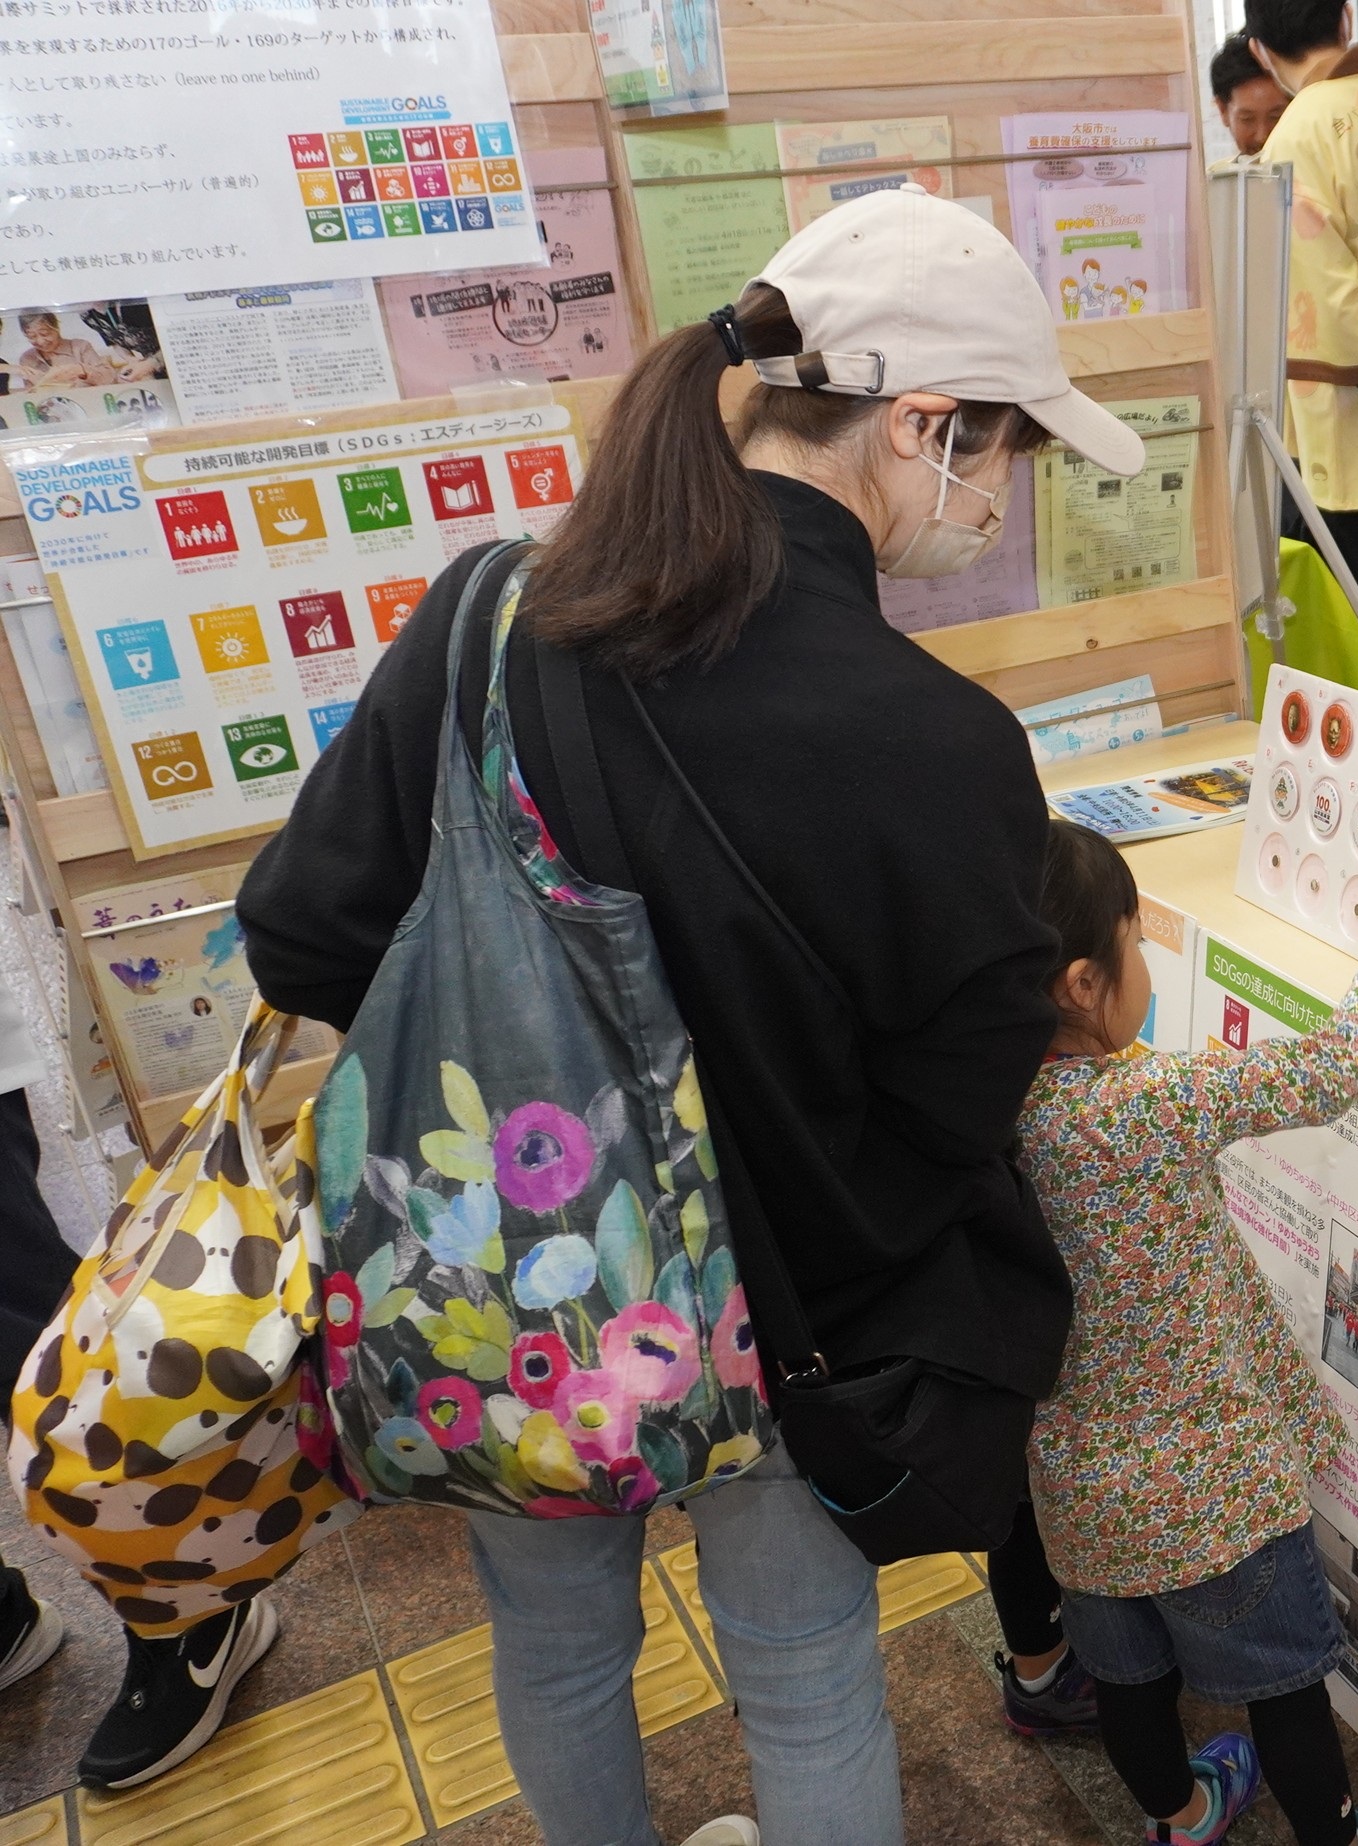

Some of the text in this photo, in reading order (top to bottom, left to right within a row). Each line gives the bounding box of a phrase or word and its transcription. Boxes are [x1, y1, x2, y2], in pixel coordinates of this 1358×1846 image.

[242, 73, 266, 83] one
[391, 96, 447, 111] GOALS
[511, 454, 520, 468] 5
[430, 465, 438, 480] 4
[20, 472, 133, 497] DEVELOPMENT
[344, 476, 353, 491] 3
[255, 489, 265, 504] 2
[27, 486, 141, 523] GOALS
[164, 502, 173, 517] 1
[371, 589, 380, 603] 9
[285, 602, 295, 617] 8
[197, 617, 206, 632] 7
[103, 633, 114, 648] 6
[313, 711, 327, 725] 14
[227, 727, 242, 743] 13
[138, 745, 153, 761] 12
